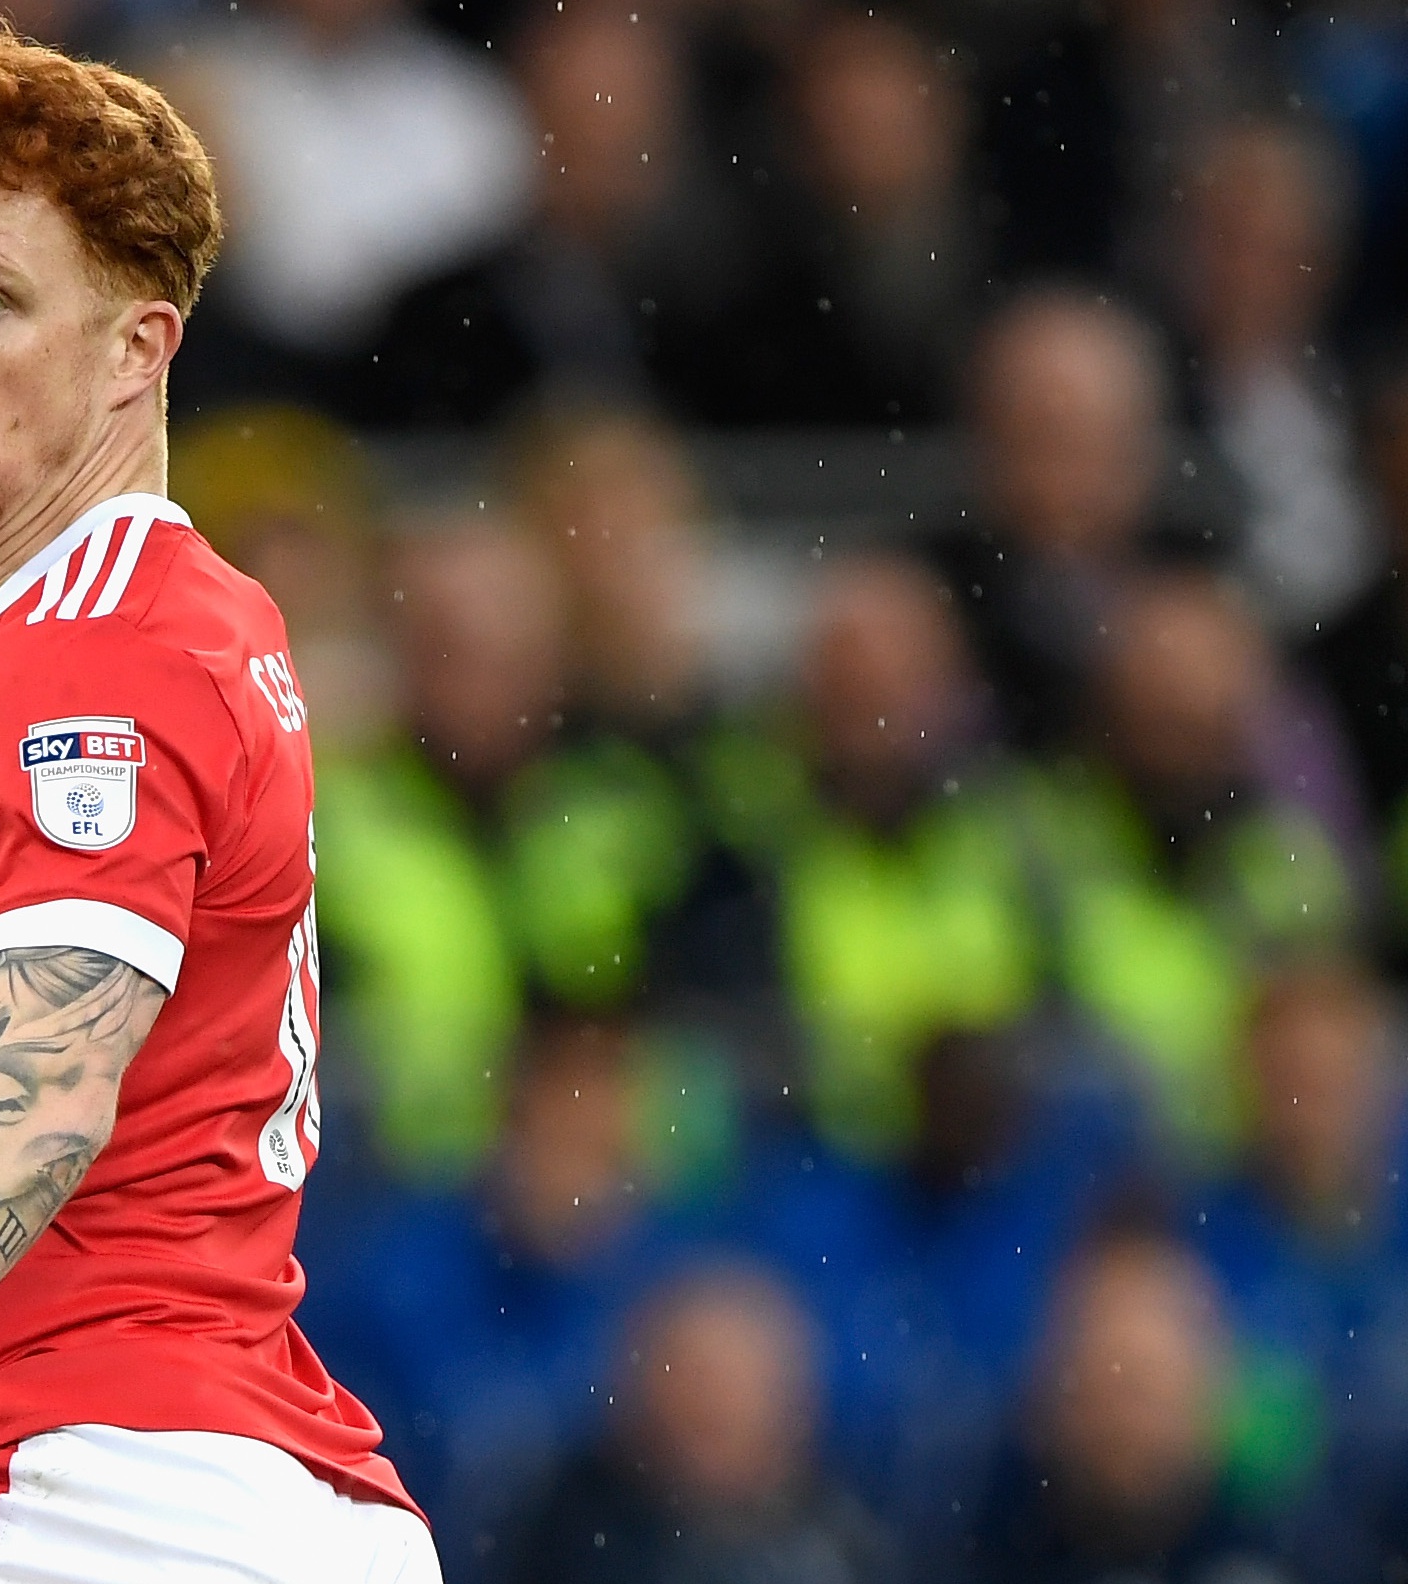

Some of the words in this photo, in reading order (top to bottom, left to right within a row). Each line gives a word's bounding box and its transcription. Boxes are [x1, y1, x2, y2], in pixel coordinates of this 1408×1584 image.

[27, 737, 74, 761] sky
[86, 735, 136, 757] BET
[40, 764, 127, 778] CHAMPIONSHIP
[72, 821, 103, 836] EFL
[277, 1161, 295, 1178] EFL
